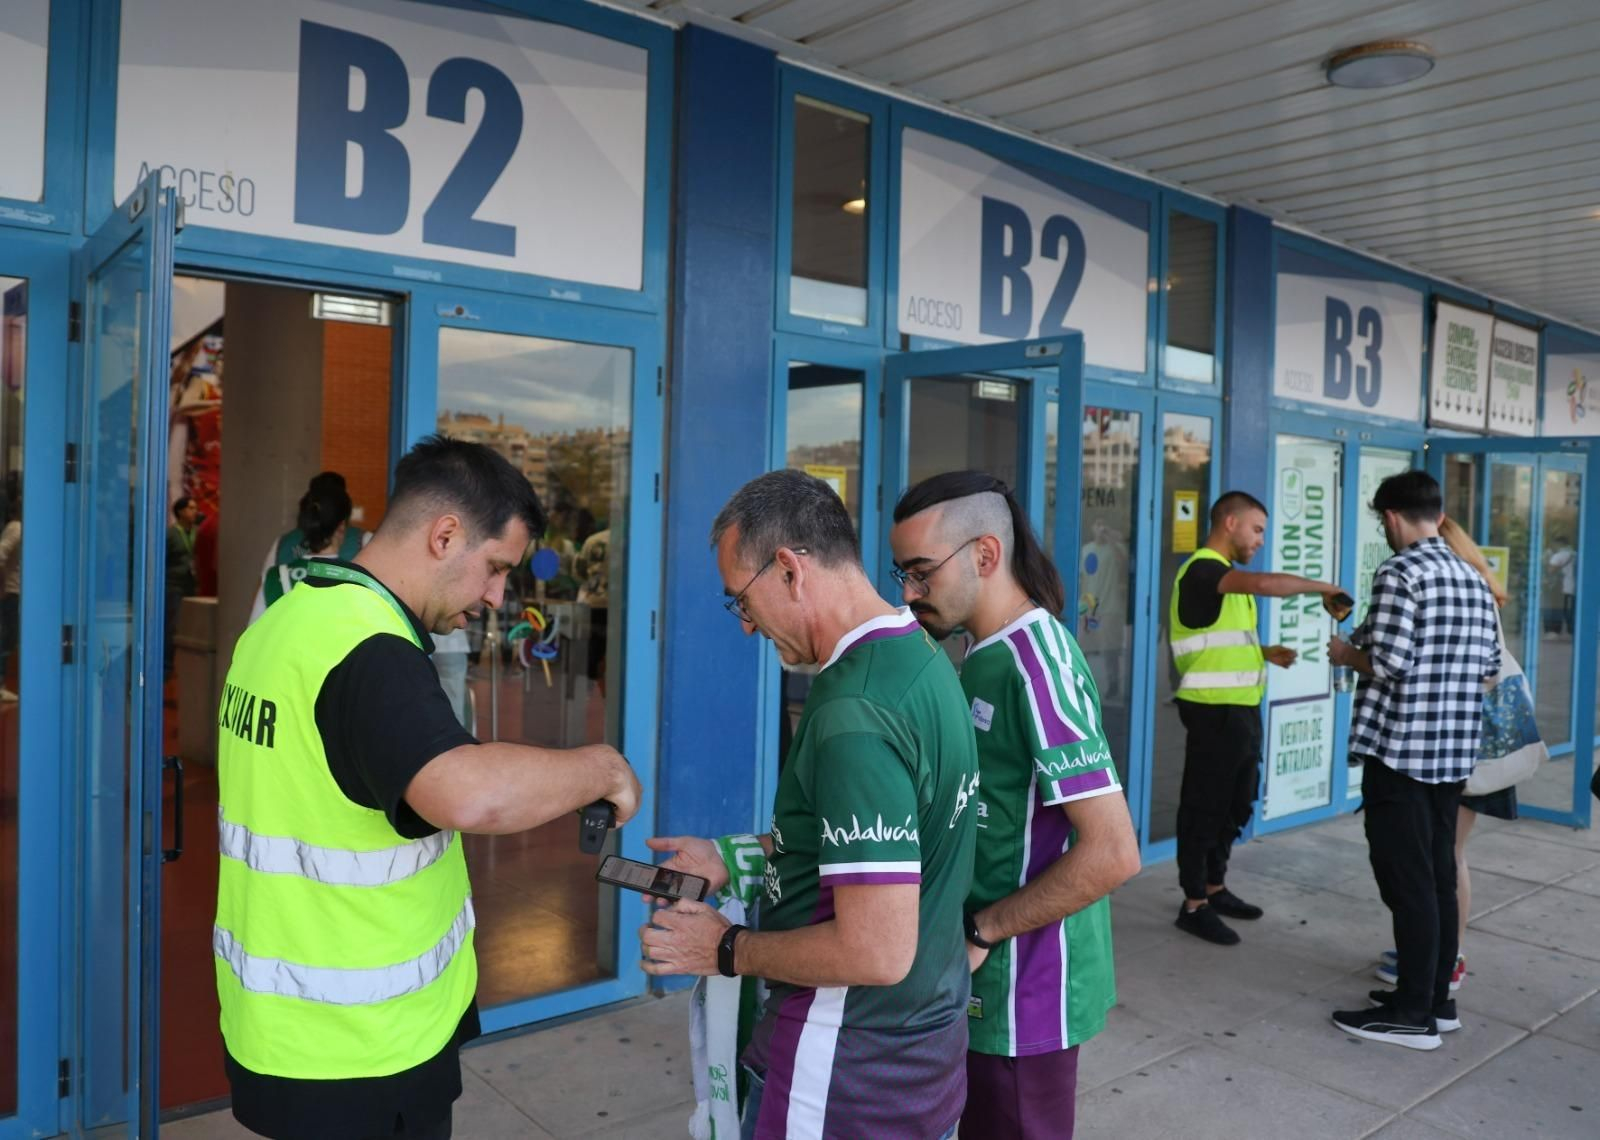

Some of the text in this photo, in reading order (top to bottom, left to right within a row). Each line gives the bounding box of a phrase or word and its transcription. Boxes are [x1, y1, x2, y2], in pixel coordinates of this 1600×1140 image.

[294, 19, 523, 257] B2
[907, 195, 1086, 340] ACCESO B2
[1323, 296, 1383, 408] B3
[1279, 524, 1302, 663] TENIÓN
[1302, 629, 1321, 663] AL
[1034, 742, 1112, 776] Andalucía
[821, 813, 920, 847] Andalucía
